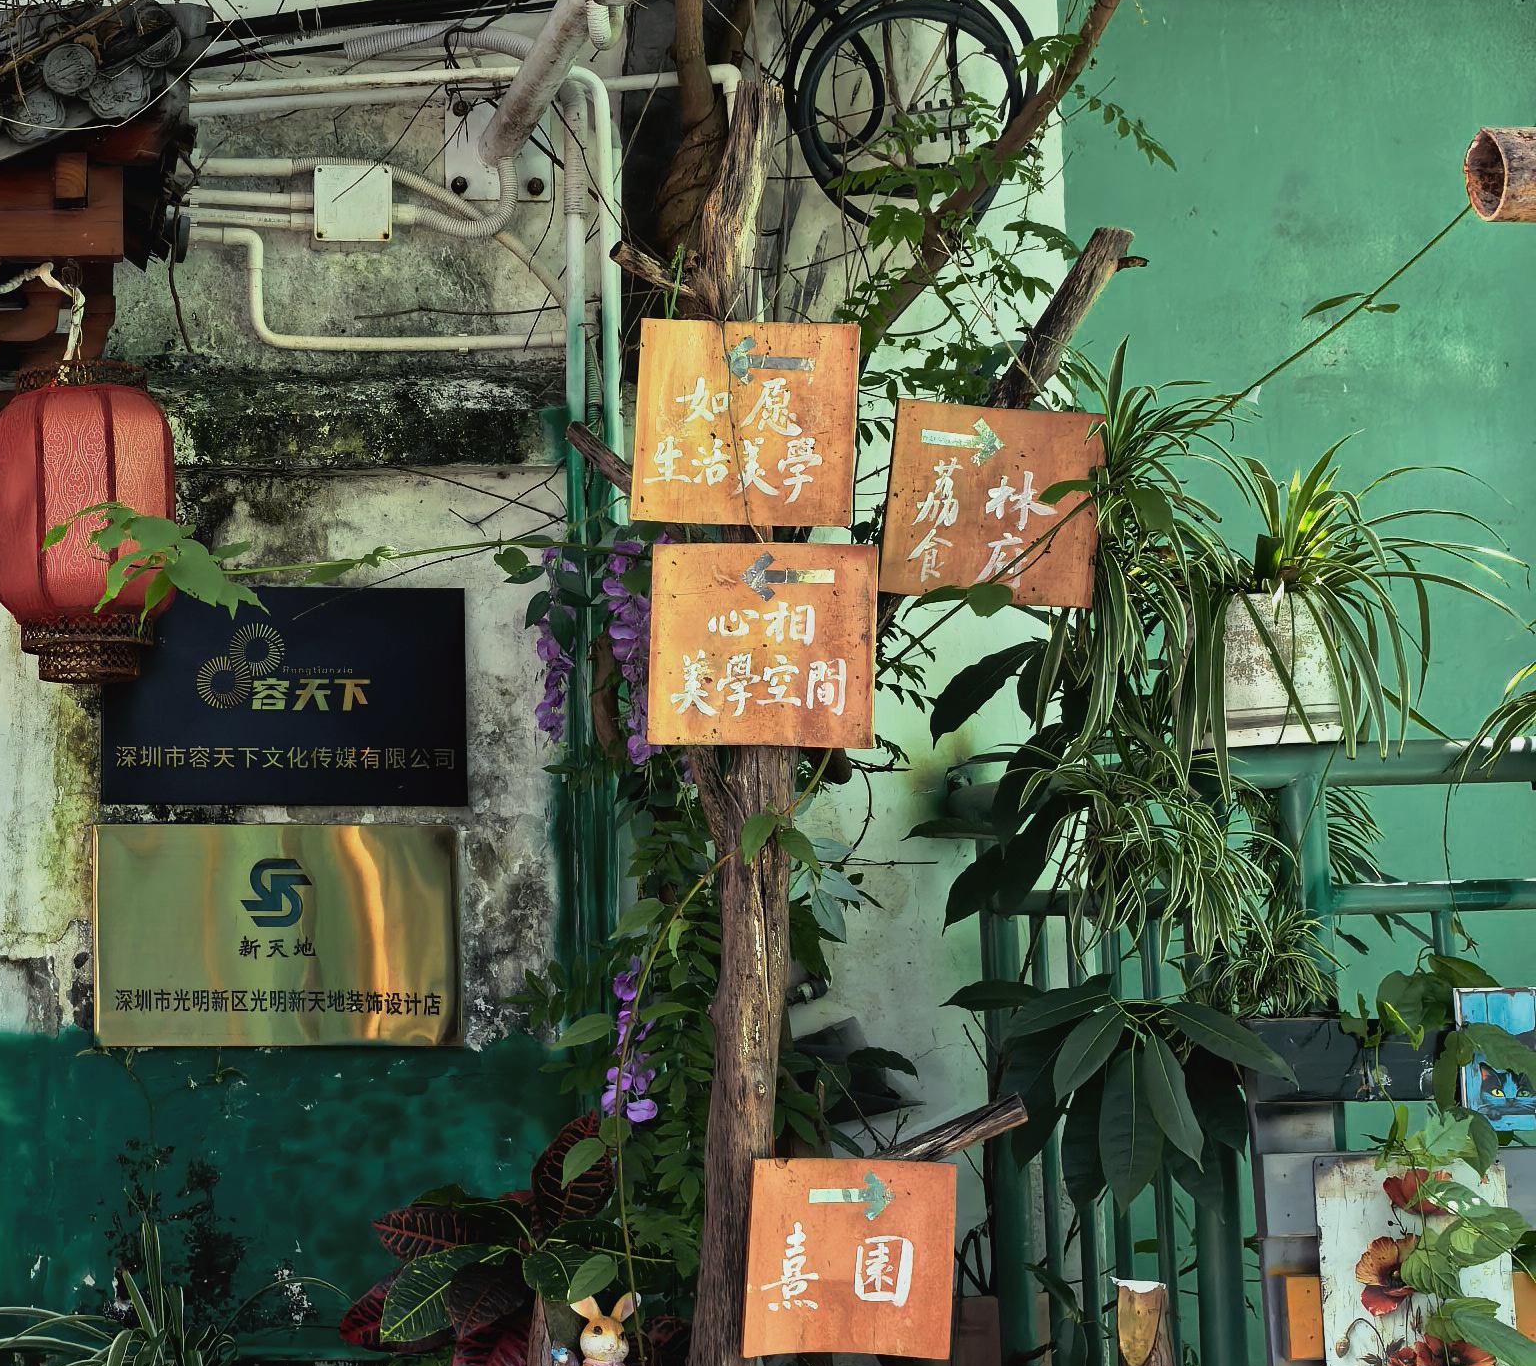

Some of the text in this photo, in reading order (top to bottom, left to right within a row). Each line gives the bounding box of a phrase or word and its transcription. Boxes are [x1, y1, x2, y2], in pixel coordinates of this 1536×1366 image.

[675, 376, 803, 436] 如愿
[643, 435, 824, 503] 生活美學
[708, 602, 816, 646] 心相
[251, 677, 371, 711] 容天下
[670, 650, 847, 718] 美學空間
[115, 745, 456, 770] 深圳市容天下文化传媒有限公司
[238, 936, 317, 960] 新天地
[115, 988, 442, 1016] 深圳市光明新区光明新天地装饰设计店
